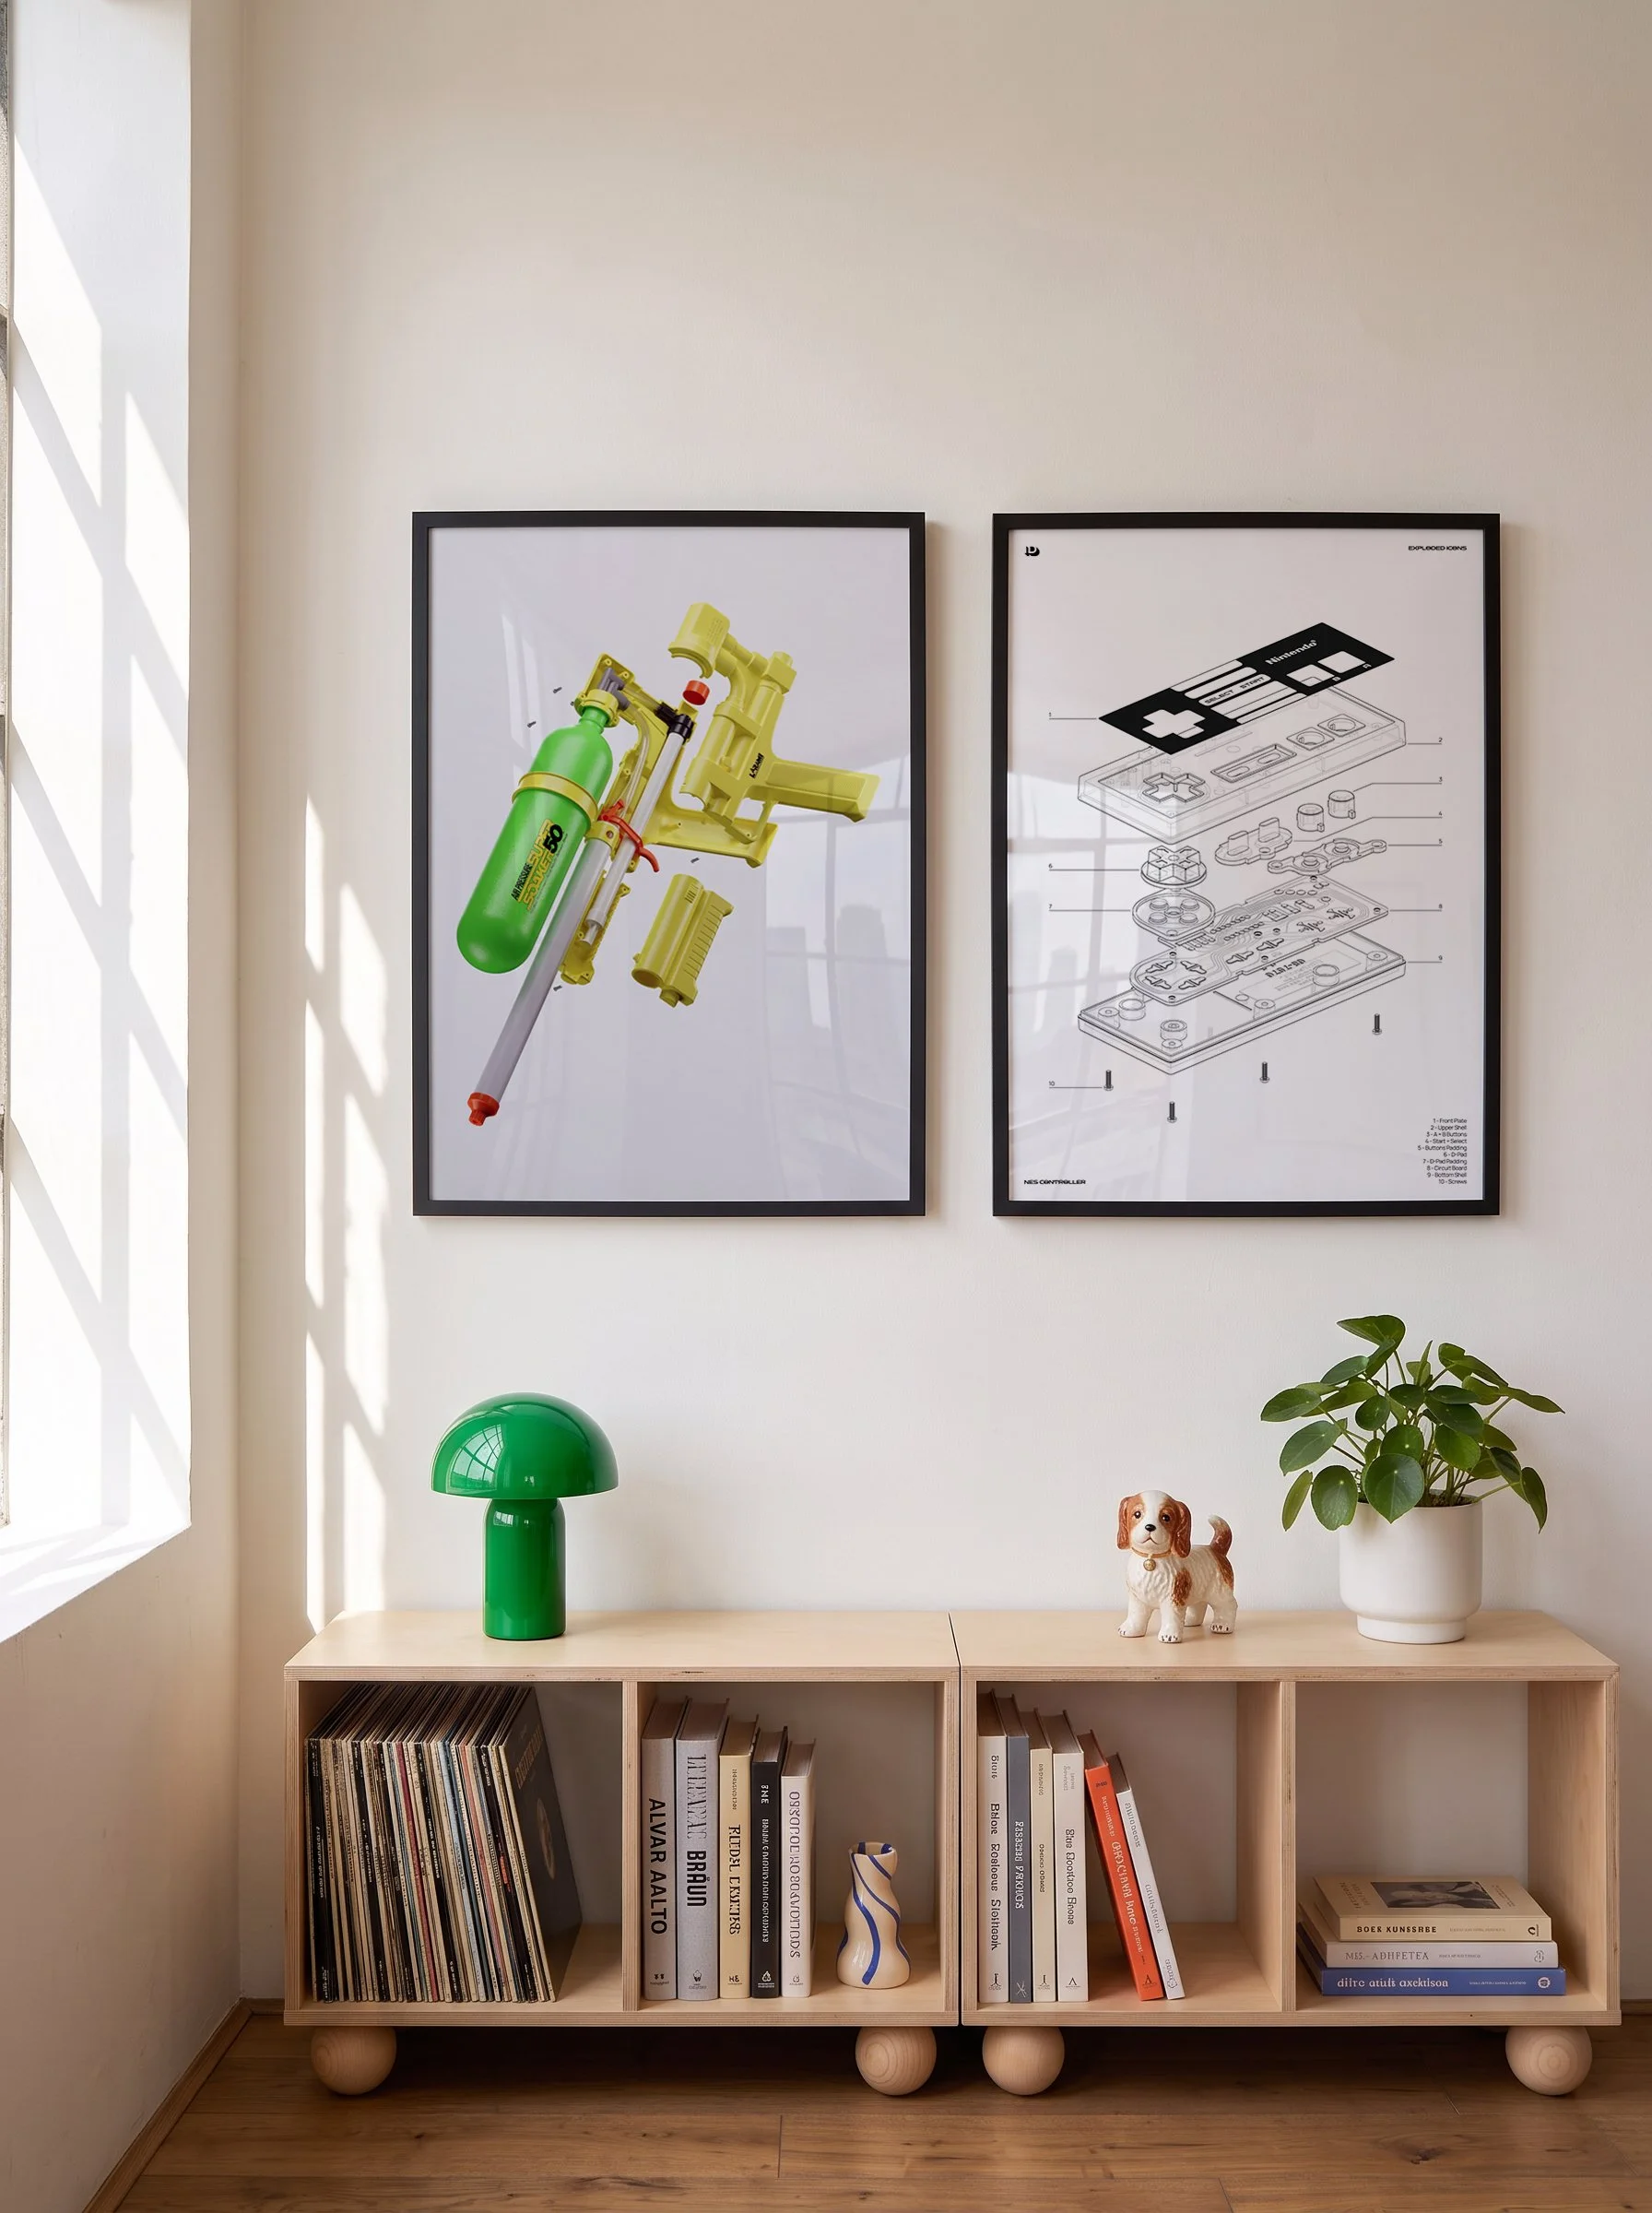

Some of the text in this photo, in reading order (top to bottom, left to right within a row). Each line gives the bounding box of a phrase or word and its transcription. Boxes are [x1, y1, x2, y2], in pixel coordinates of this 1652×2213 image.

[1204, 676, 1265, 704] SELECT START
[543, 823, 563, 854] 50
[649, 1798, 667, 1935] ALVAR AALTO
